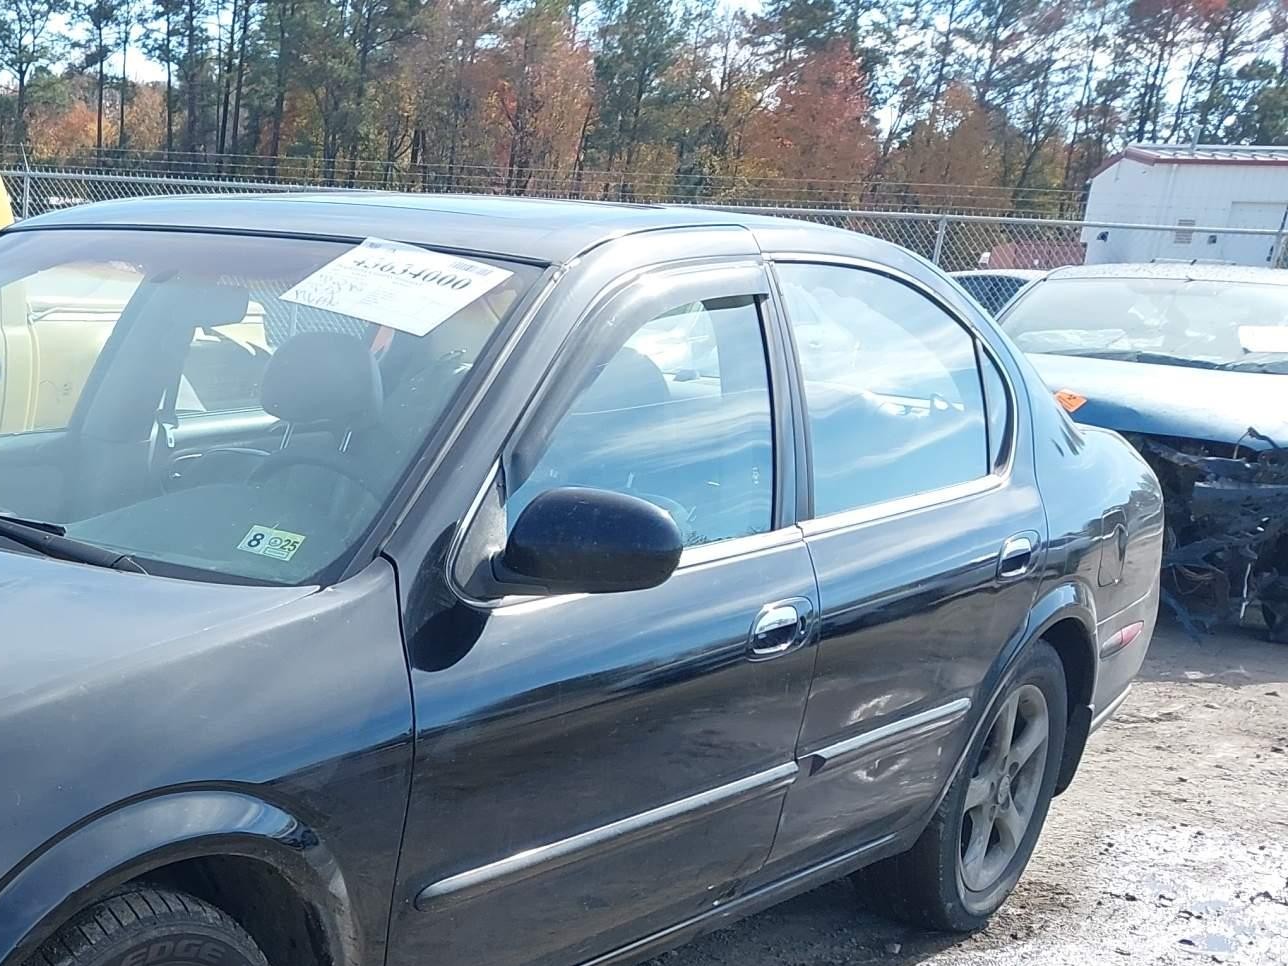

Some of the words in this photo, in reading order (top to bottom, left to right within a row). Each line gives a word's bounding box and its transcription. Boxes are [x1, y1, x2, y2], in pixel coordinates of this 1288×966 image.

[352, 257, 473, 291] 43634000
[247, 532, 265, 548] 8
[279, 538, 300, 552] 25
